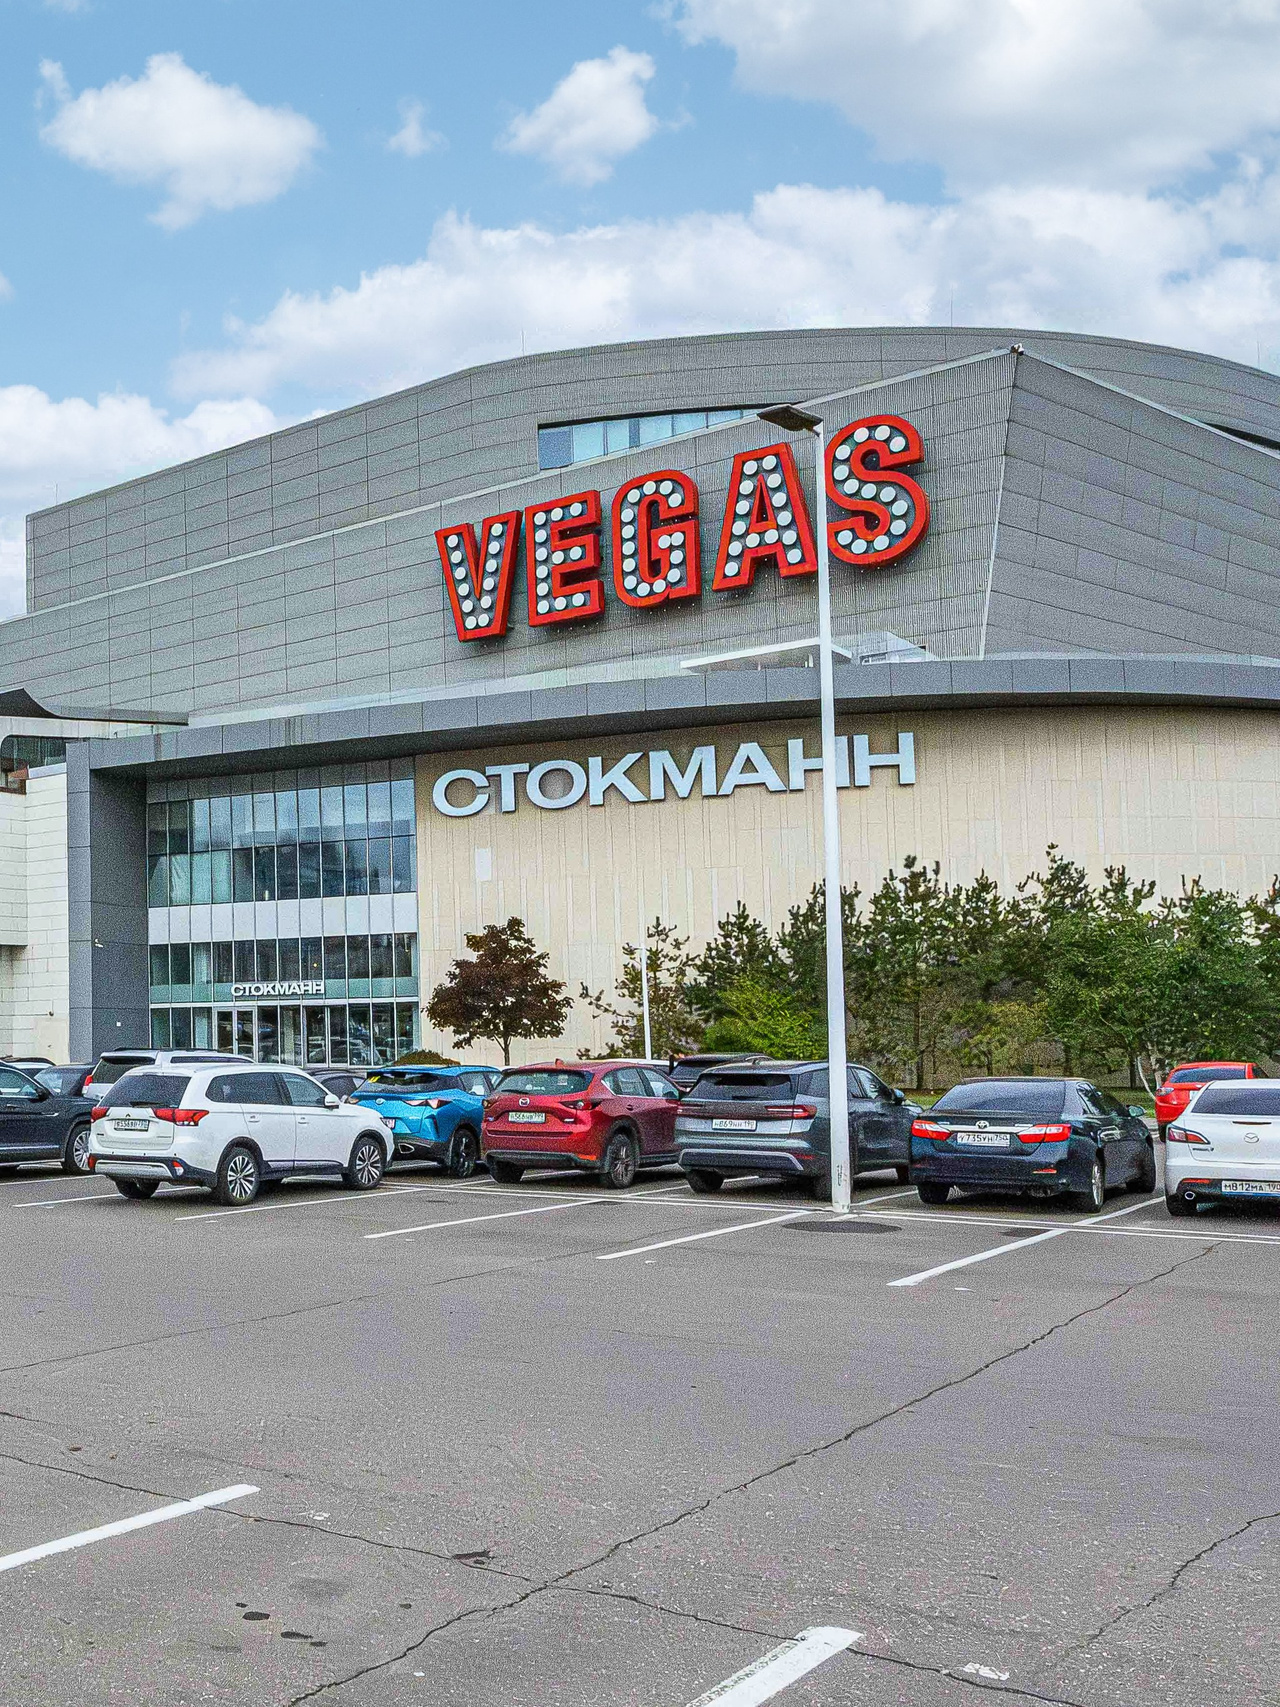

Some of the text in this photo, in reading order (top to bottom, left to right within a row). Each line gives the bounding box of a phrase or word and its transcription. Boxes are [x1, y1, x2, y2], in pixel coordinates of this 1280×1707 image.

[435, 414, 930, 642] VEGAS
[432, 731, 917, 817] СТОКМАНН
[231, 980, 325, 996] СТОКМАНН
